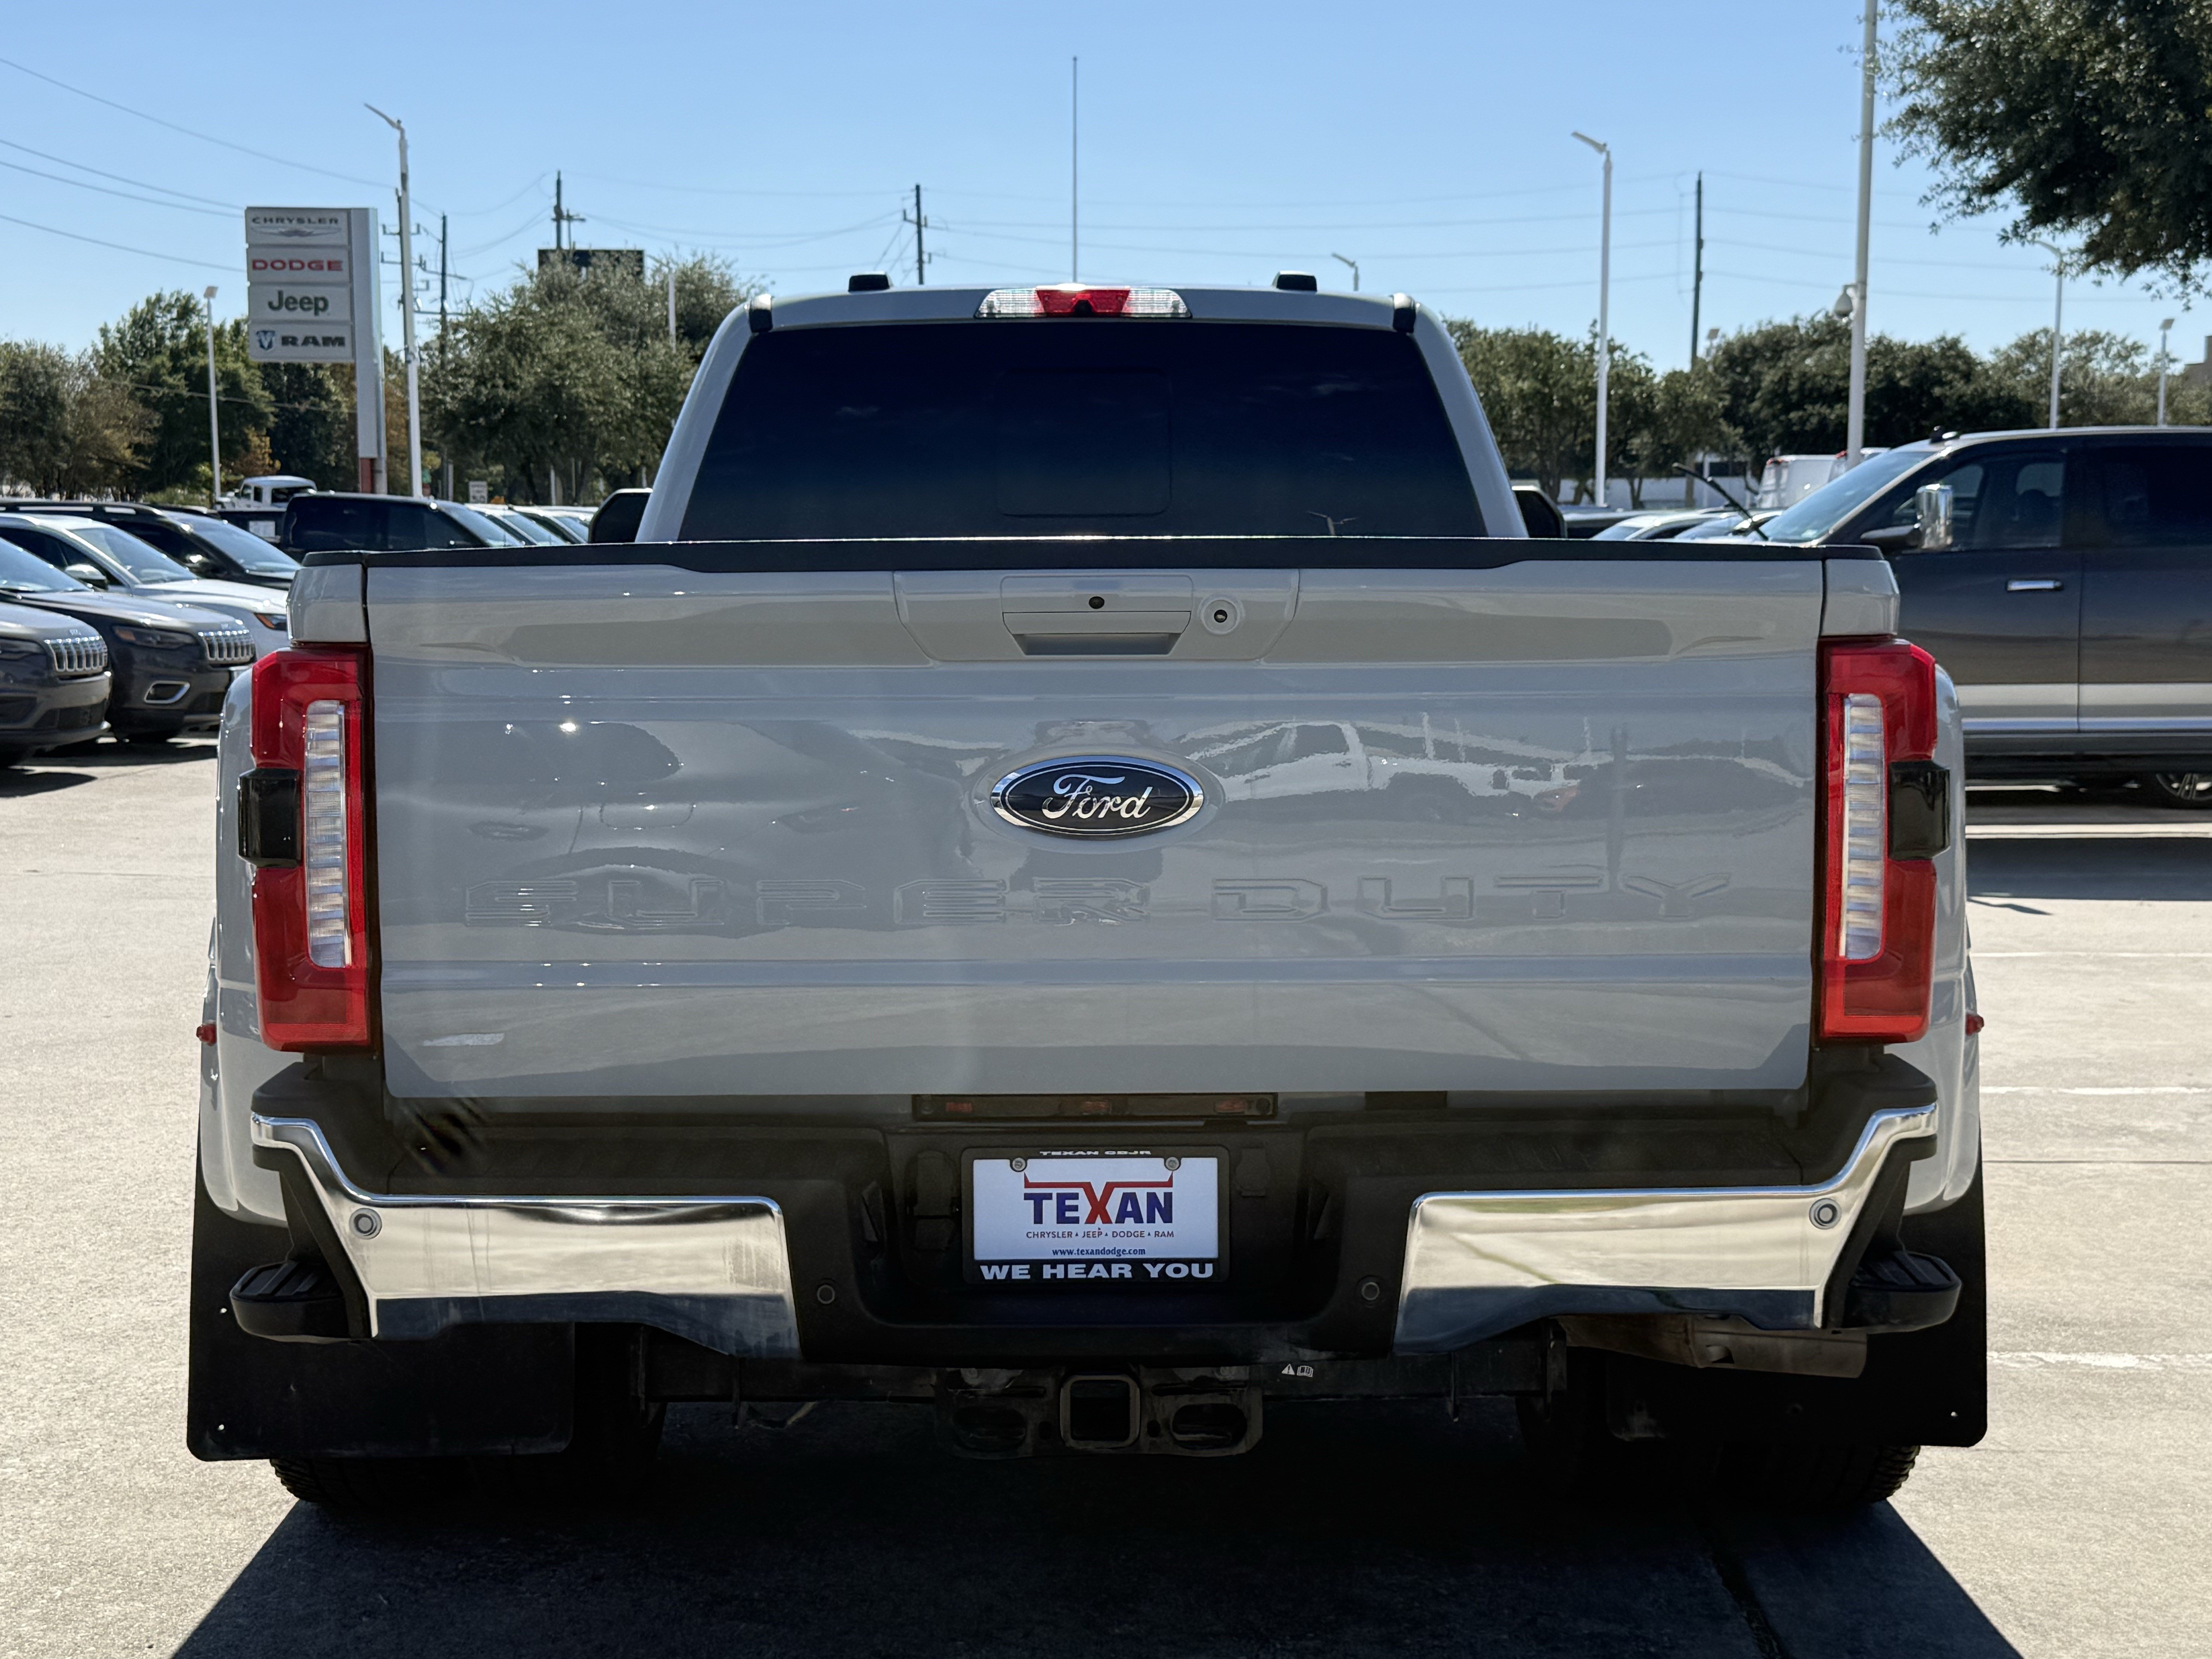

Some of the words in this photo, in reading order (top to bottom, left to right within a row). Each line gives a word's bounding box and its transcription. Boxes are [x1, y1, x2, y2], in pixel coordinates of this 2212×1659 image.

[252, 259, 343, 271] DODGE
[268, 290, 329, 316] Jeep
[281, 335, 345, 347] RAM
[1042, 774, 1152, 819] Ford
[465, 878, 1151, 927] SUPER
[1212, 873, 1731, 921] DUTY
[1024, 1181, 1173, 1224] TEXAN
[1052, 1247, 1146, 1257] www.texandodge.com
[980, 1264, 1031, 1279] WE
[1043, 1264, 1132, 1278] HEAR
[1143, 1263, 1214, 1278] YOU
